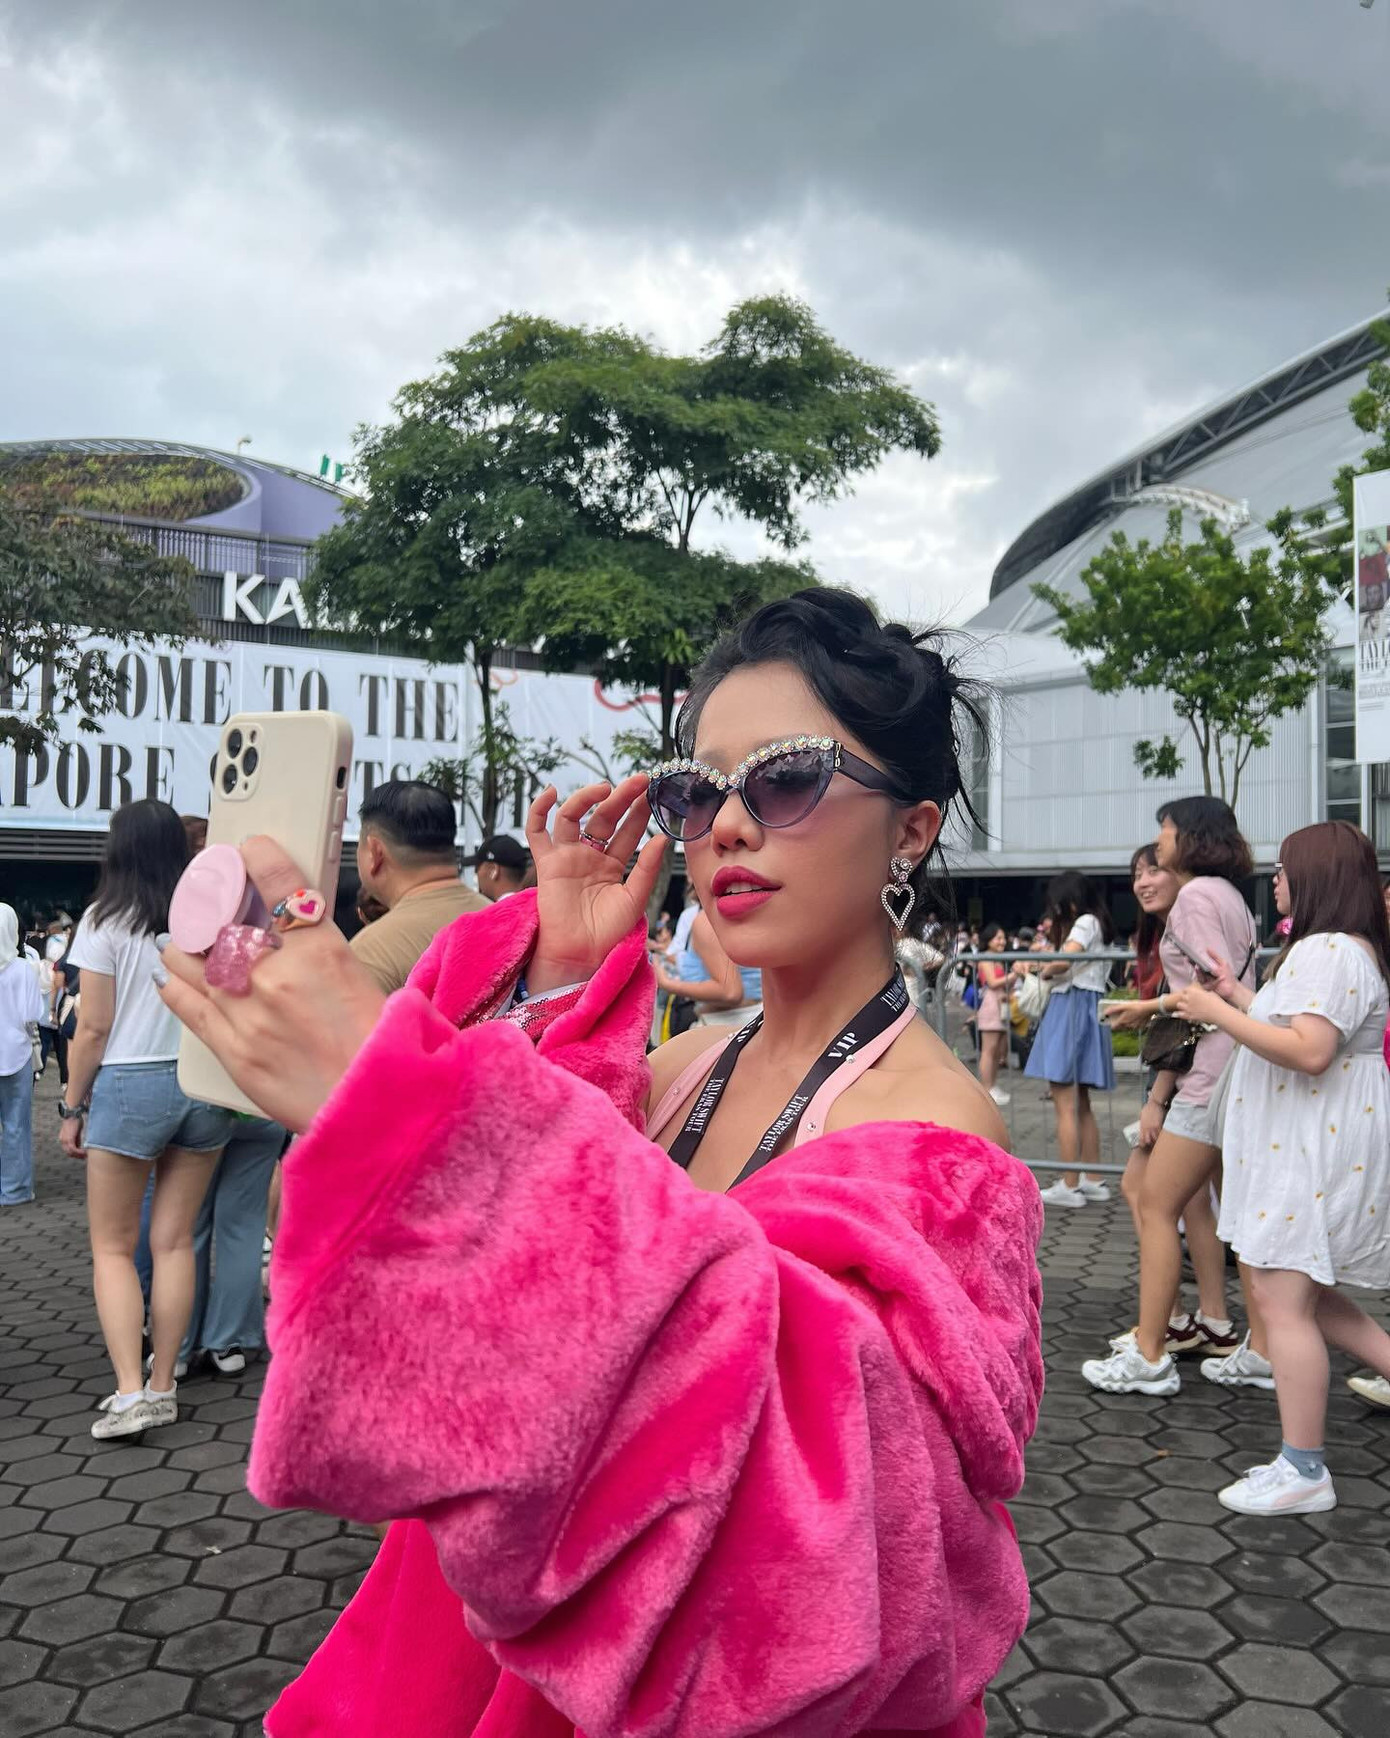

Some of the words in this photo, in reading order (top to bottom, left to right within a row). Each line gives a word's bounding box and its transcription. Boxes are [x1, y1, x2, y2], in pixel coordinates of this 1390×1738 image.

[263, 664, 329, 713] TO
[359, 673, 460, 742] THE
[828, 1032, 859, 1059] VIP
[759, 1120, 786, 1151] TAYLOR
[781, 1094, 803, 1120] SWIFT
